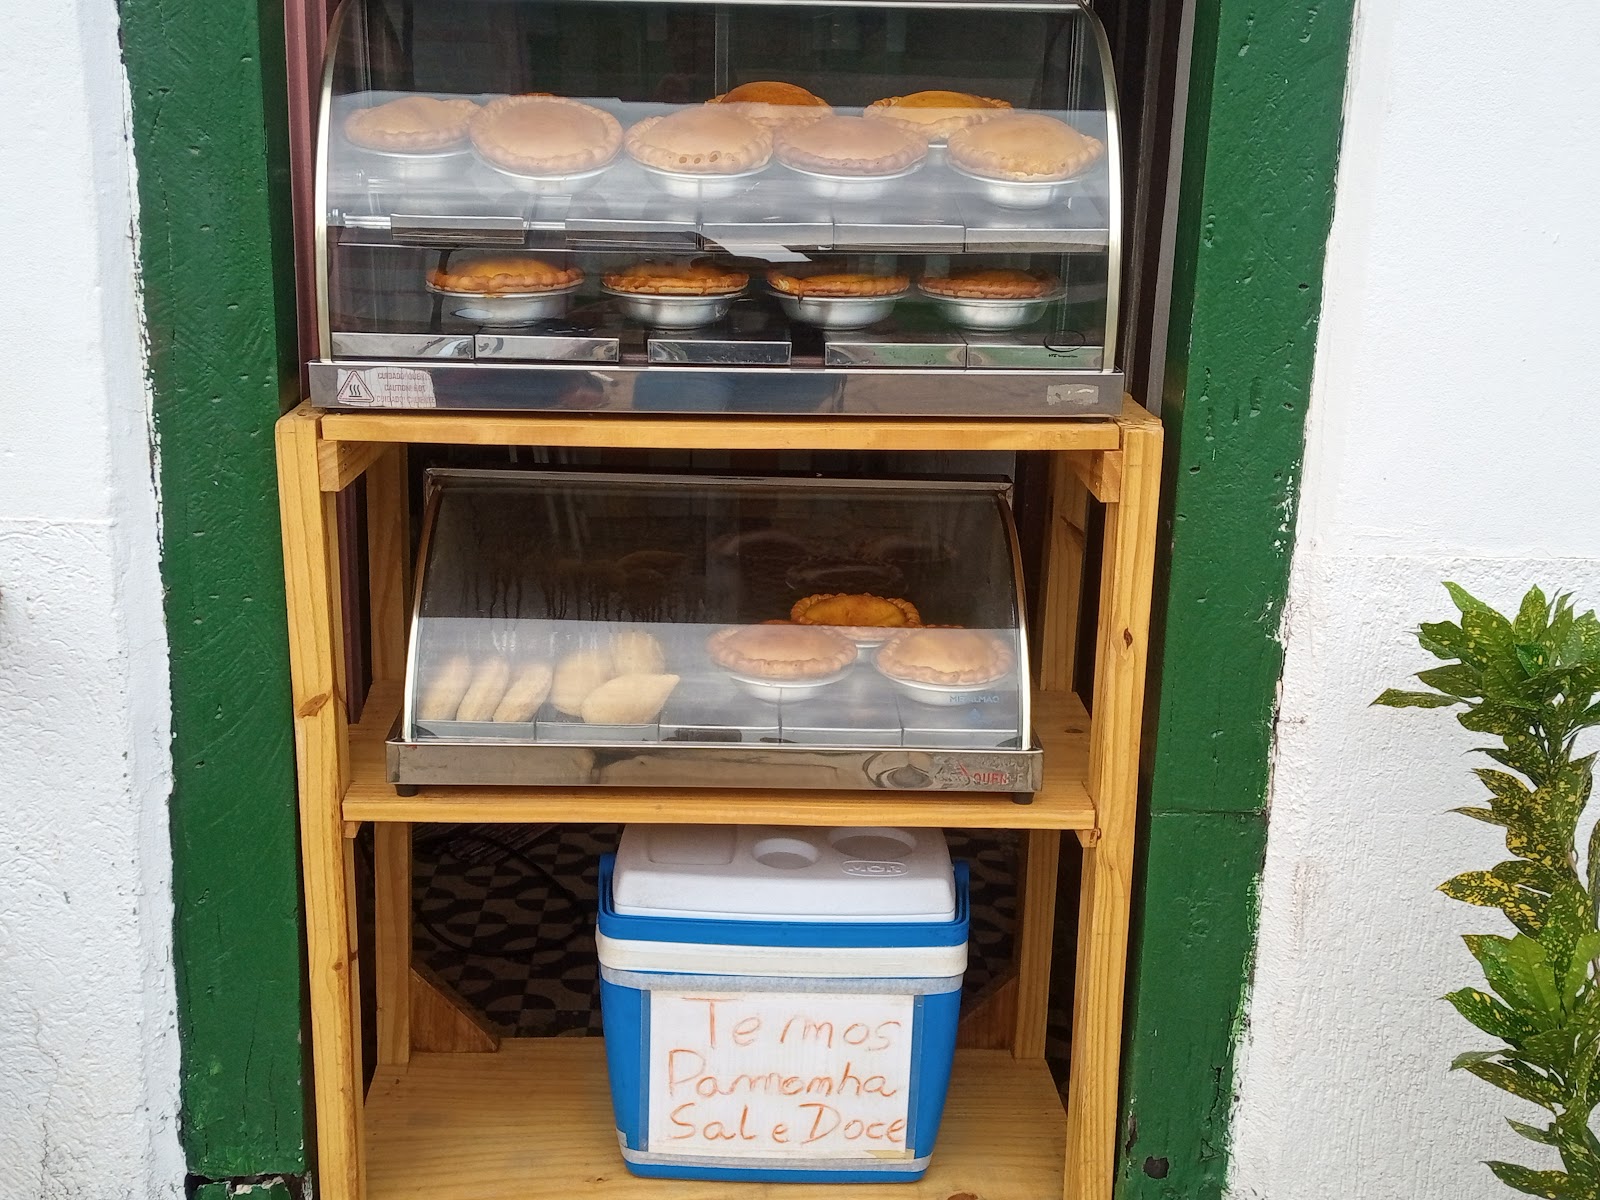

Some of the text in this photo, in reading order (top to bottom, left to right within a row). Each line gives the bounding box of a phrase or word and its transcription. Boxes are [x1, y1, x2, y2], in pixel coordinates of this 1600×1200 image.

[682, 996, 901, 1051] Termos
[666, 1102, 906, 1144] Sal e Doce
